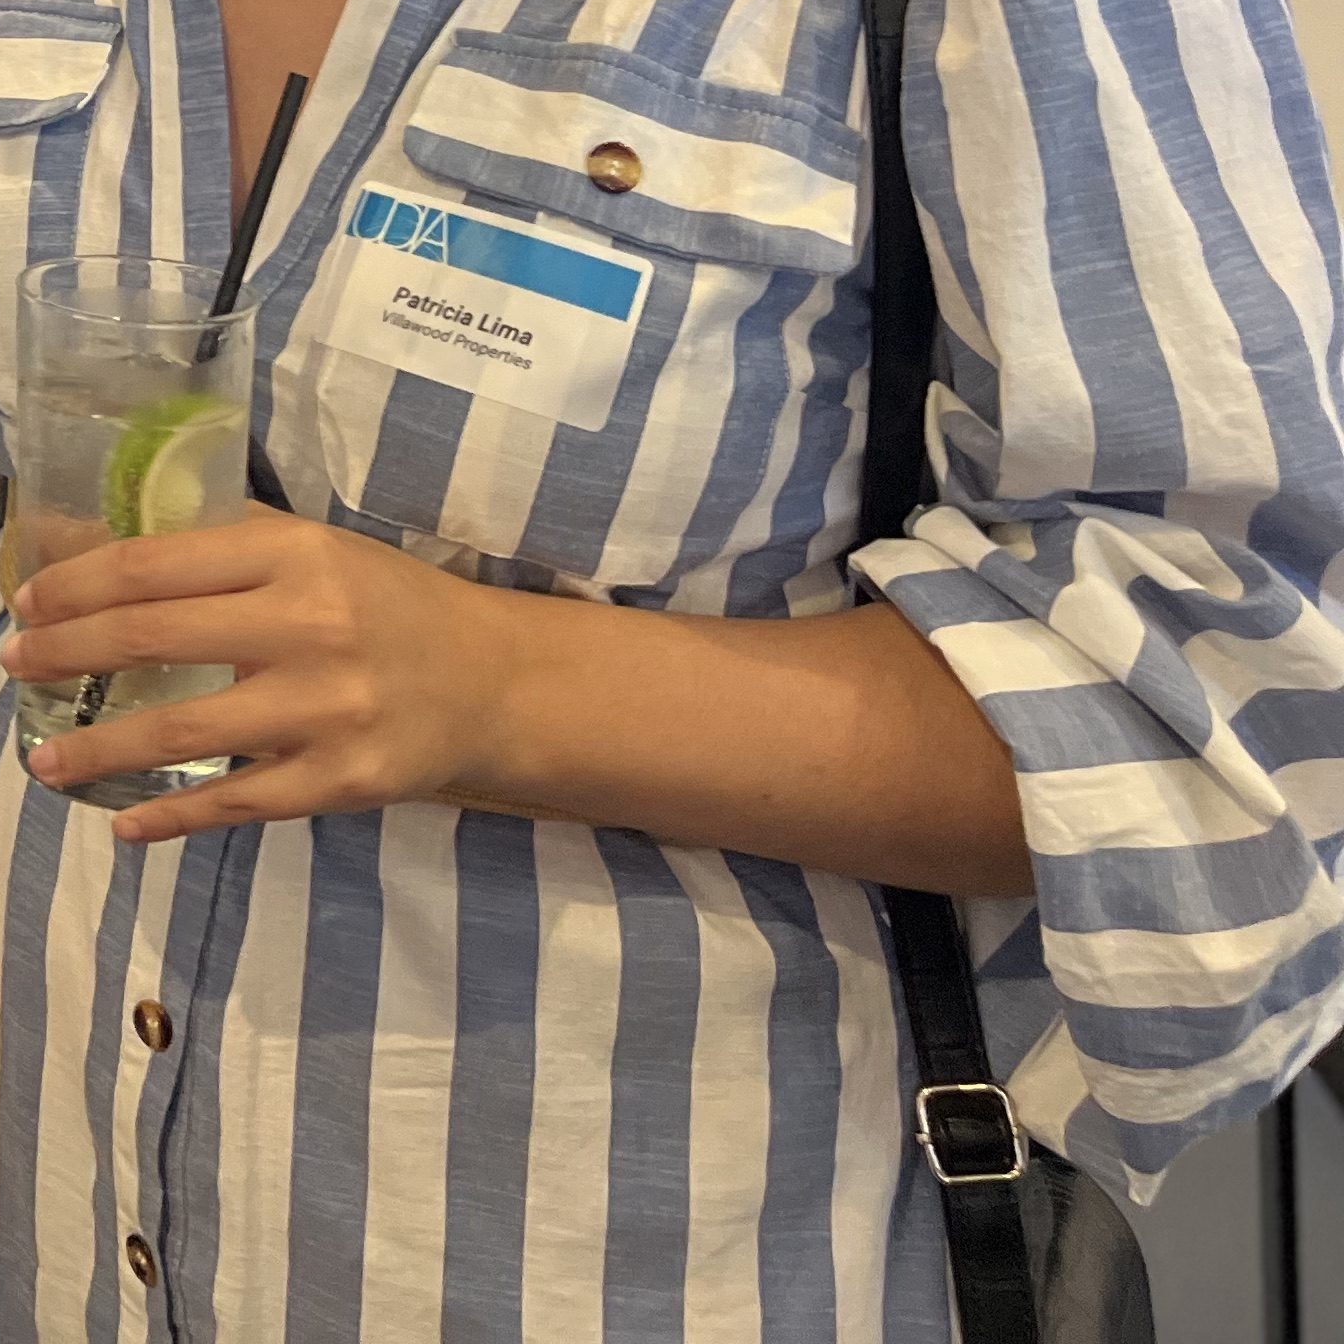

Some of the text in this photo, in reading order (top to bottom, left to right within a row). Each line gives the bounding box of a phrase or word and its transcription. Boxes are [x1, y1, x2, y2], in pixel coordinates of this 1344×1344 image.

[381, 308, 534, 370] Villawood Properties
[392, 286, 534, 346] Patricia Lima
